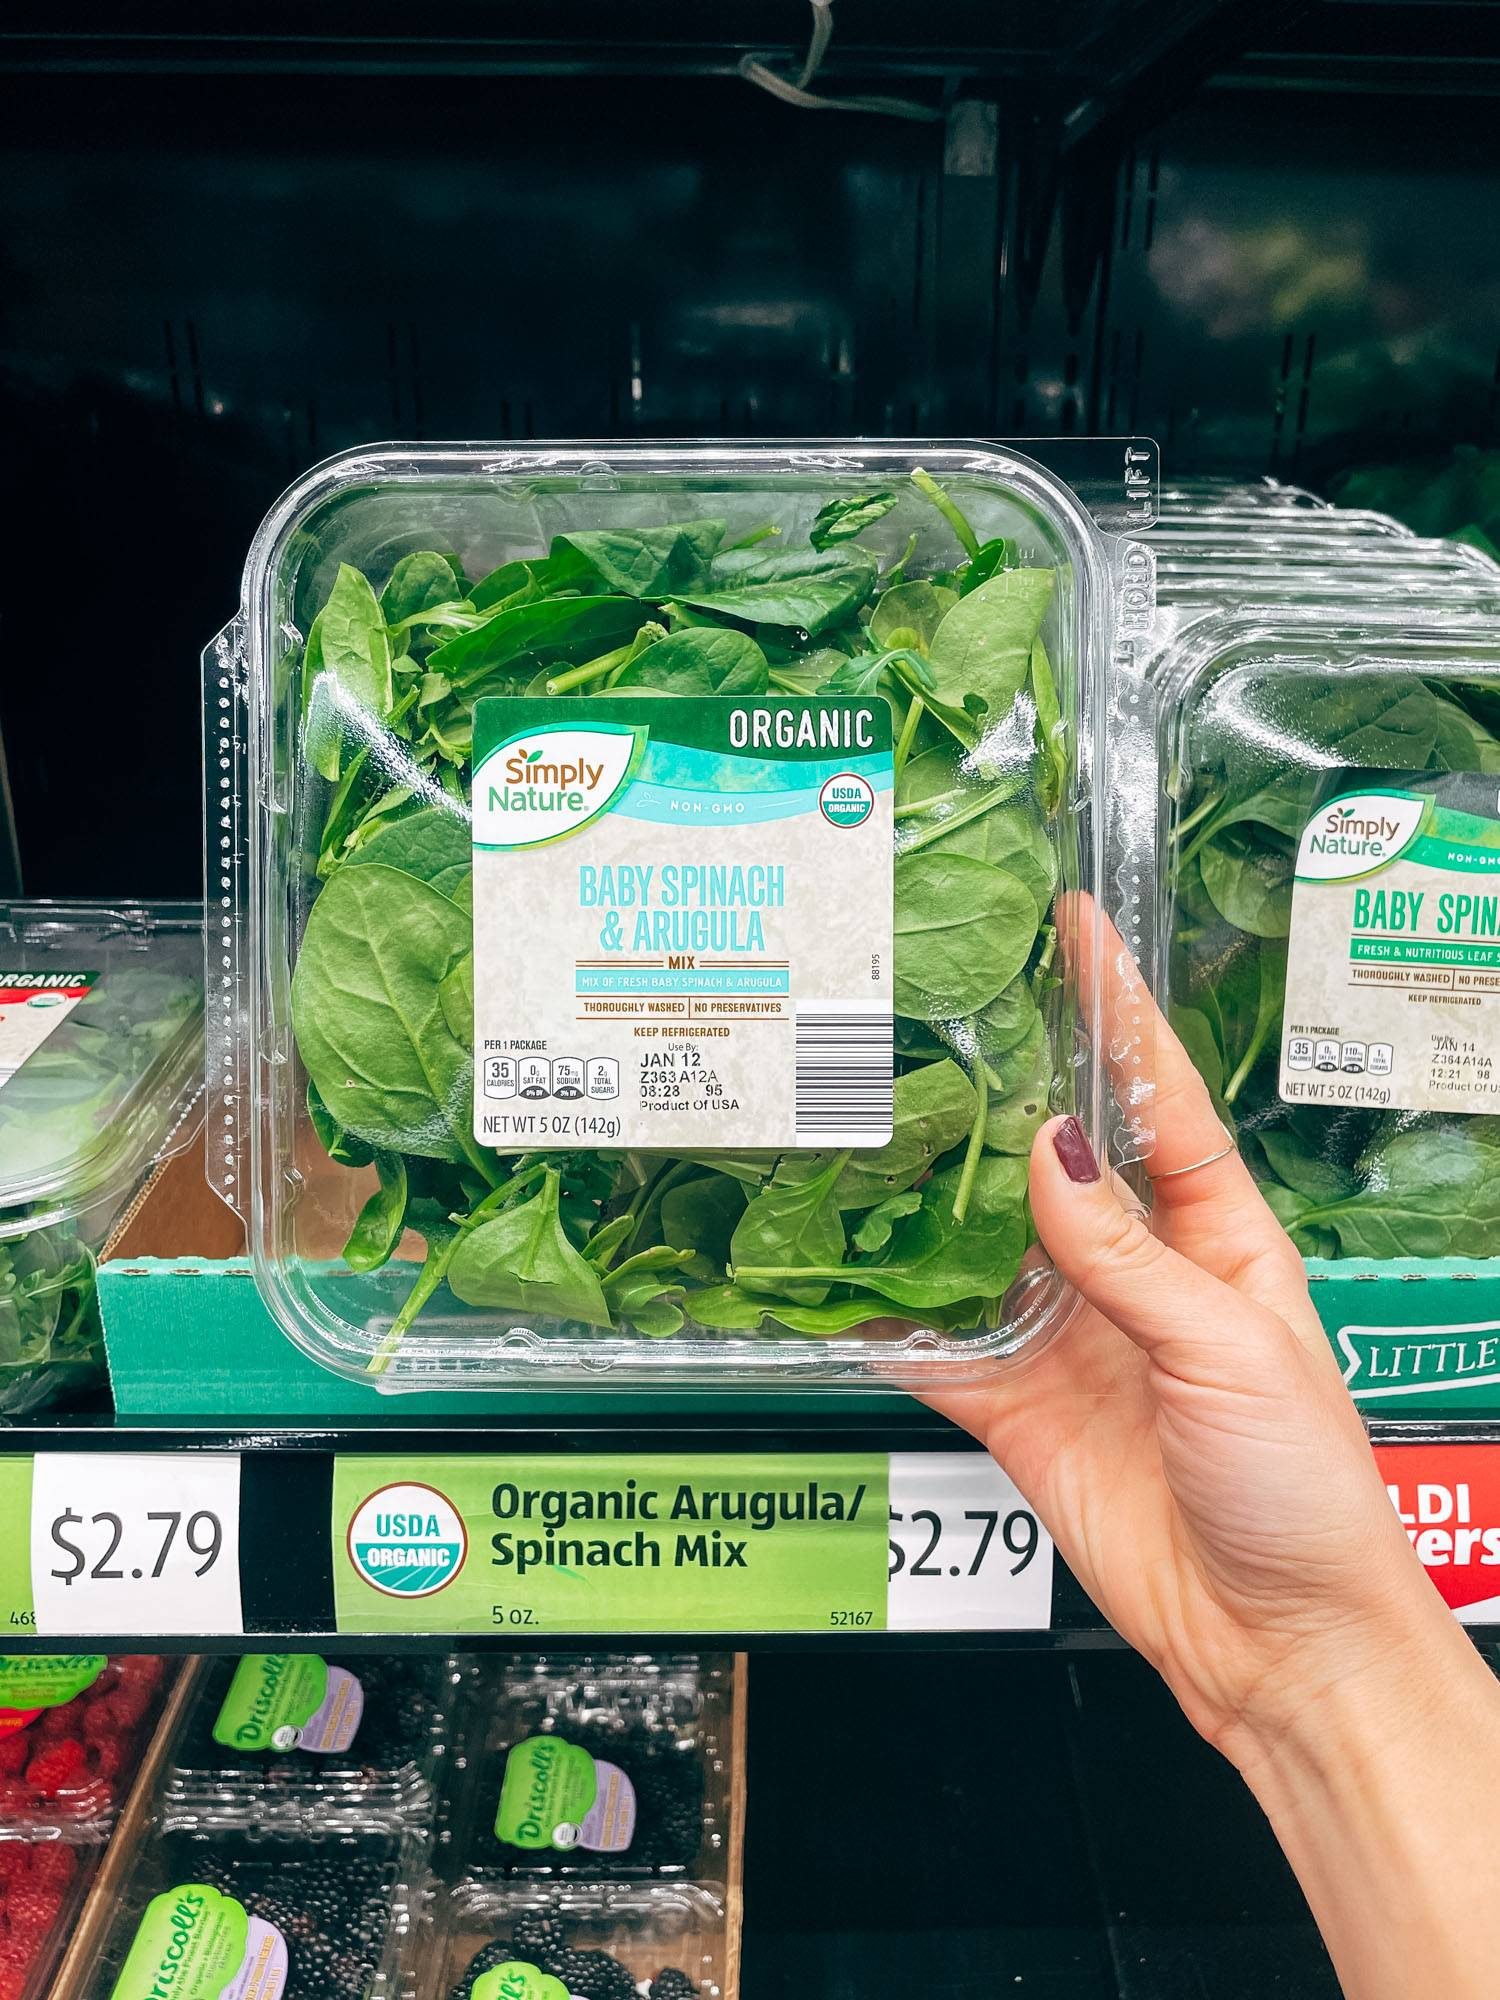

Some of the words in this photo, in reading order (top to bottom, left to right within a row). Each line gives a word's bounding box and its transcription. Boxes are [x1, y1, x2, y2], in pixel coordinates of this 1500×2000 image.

[1124, 447, 1150, 519] LIFT
[729, 709, 874, 748] ORGANIC
[506, 757, 604, 791] Simply
[831, 787, 862, 799] USDA
[670, 800, 745, 814] NON-GMO
[828, 803, 866, 813] ORGANIC
[1325, 814, 1400, 841] Simply
[579, 865, 654, 907] BABY
[661, 865, 785, 907] SPINACH
[1353, 889, 1424, 931] BABY
[1437, 893, 1500, 936] SPIN
[600, 910, 624, 951] &
[633, 911, 765, 951] ARUGULA
[1357, 945, 1390, 956] FRESH
[1394, 947, 1401, 956] &
[1405, 947, 1464, 960] NUTRITIOUS
[1468, 951, 1493, 962] LEAF
[668, 956, 695, 969] MIX
[871, 953, 880, 981] 88195
[0, 974, 86, 988] RGANIC
[582, 977, 599, 988] MIX
[603, 977, 614, 988] OF
[618, 977, 648, 988] FRESH
[652, 977, 679, 988] BABY
[682, 977, 722, 988] SPINACH
[726, 977, 733, 988] &
[737, 977, 782, 988] ARUGULA
[1352, 970, 1410, 981] THOROUGHLY
[1413, 973, 1450, 984] WASHED
[1458, 975, 1470, 985] NO
[584, 1002, 644, 1013] THOROUGHLY
[648, 1002, 685, 1013] WASHED
[694, 1002, 708, 1013] NO
[711, 1002, 782, 1013] PRESERVATIVES
[1408, 994, 1427, 1003] KEEP
[1429, 995, 1482, 1006] REFRIGERATED
[634, 1027, 659, 1037] KEEP
[662, 1027, 730, 1037] REFRIGERATED
[484, 1040, 501, 1051] PER
[510, 1040, 547, 1051] PACKAGE
[668, 1042, 684, 1052] Use
[1294, 1042, 1309, 1055] 35
[1433, 1040, 1458, 1052] JAN
[1462, 1043, 1476, 1052] 14
[640, 1053, 675, 1067] JAN
[682, 1052, 700, 1067] 12
[1462, 1056, 1493, 1067] A14A
[492, 1062, 509, 1078] 35
[640, 1070, 676, 1084] Z363
[679, 1069, 719, 1083] A12A
[1430, 1068, 1461, 1079] 12:21
[1477, 1070, 1490, 1080] 98
[523, 1077, 534, 1085] SAT
[535, 1077, 546, 1085] FAT
[556, 1077, 580, 1085] SODIUM
[594, 1077, 612, 1085] TOTAL
[1428, 1080, 1470, 1092] Product
[1474, 1081, 1488, 1093] Of
[591, 1086, 615, 1094] SUGARS
[640, 1085, 680, 1097] 08:28
[705, 1084, 723, 1096] 95
[1285, 1082, 1306, 1096] NET
[1307, 1083, 1326, 1098] WT
[1327, 1085, 1335, 1098] 5
[1338, 1085, 1353, 1099] OZ
[1355, 1086, 1391, 1105] (142g)
[640, 1100, 690, 1111] Product
[693, 1100, 708, 1111] Of
[712, 1099, 740, 1110] USA
[483, 1115, 510, 1133] NET
[512, 1115, 536, 1133] WT
[539, 1115, 548, 1134] 5
[552, 1116, 571, 1134] OZ
[575, 1115, 621, 1138] (142g)
[1368, 1337, 1498, 1378] LITTLE
[492, 1479, 659, 1529] Organic
[669, 1482, 867, 1531] Arugula/
[376, 1513, 441, 1537] USDA
[51, 1507, 223, 1585] $2.79
[491, 1529, 660, 1575] Spinach
[674, 1530, 748, 1567] Mix
[1406, 1527, 1500, 1567] ers
[366, 1547, 451, 1567] ORGANIC
[492, 1605, 505, 1625] 5
[510, 1610, 540, 1625] oz.
[830, 1611, 873, 1626] 52167
[237, 1654, 289, 1742] Driscoll
[516, 1743, 556, 1840] Driscoll's
[144, 1889, 205, 2000] riscoll's
